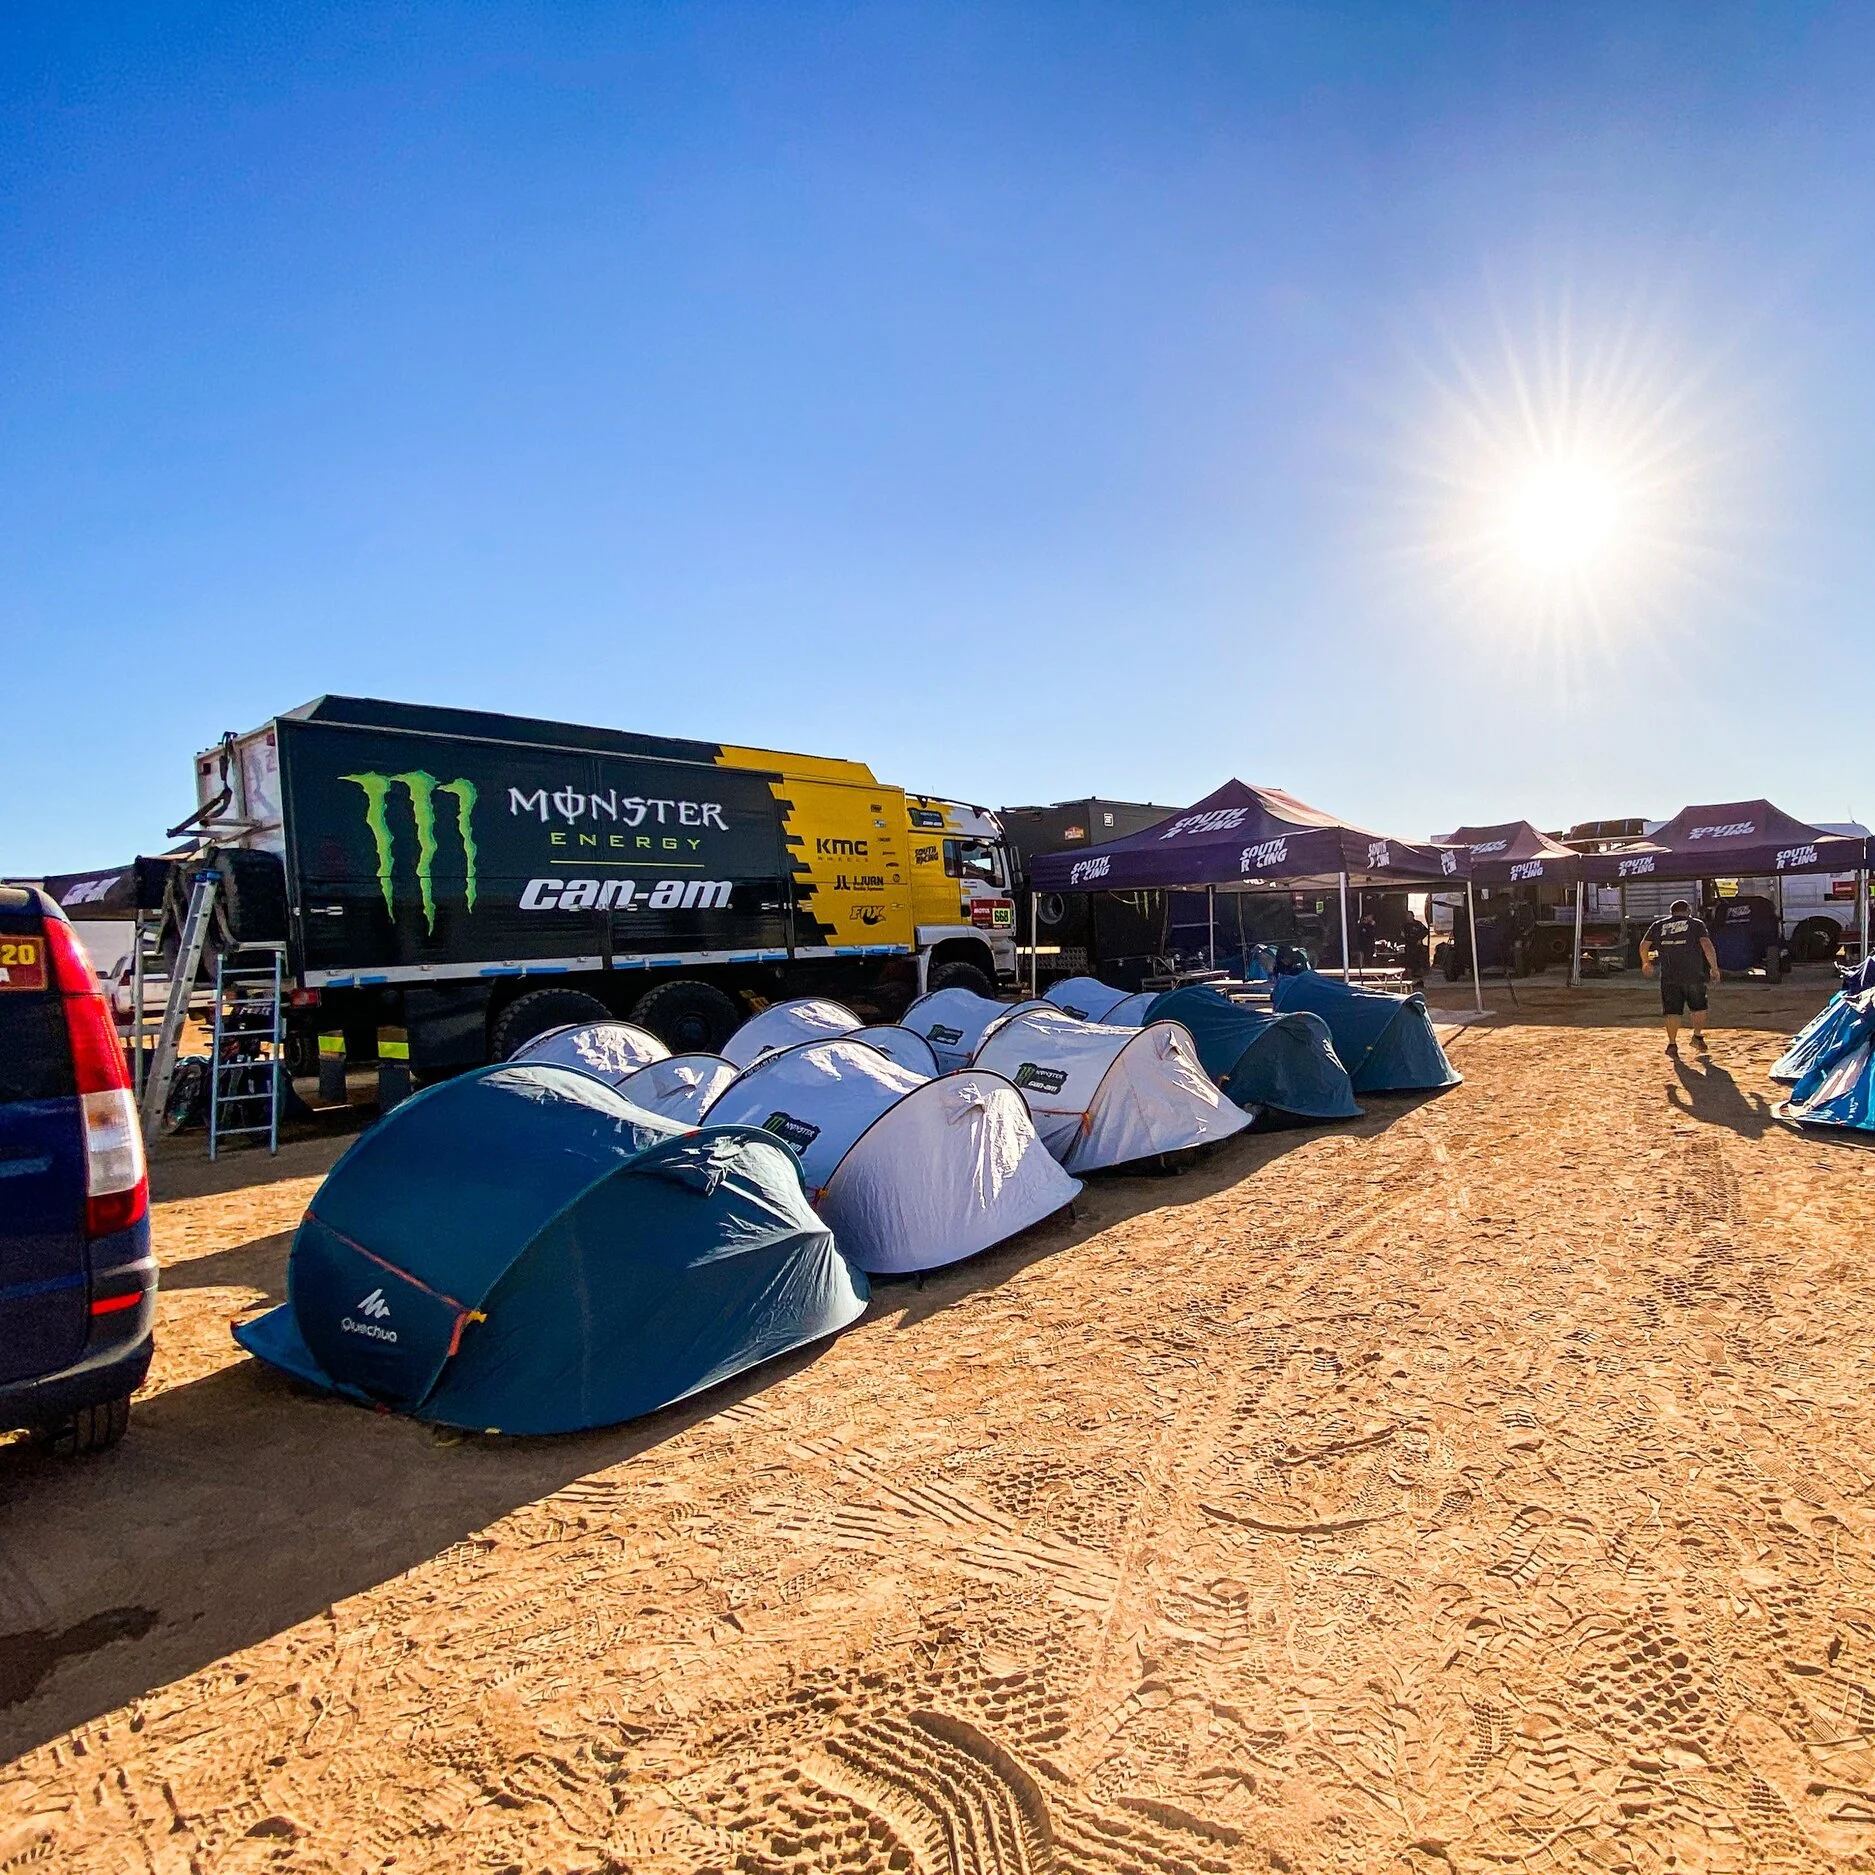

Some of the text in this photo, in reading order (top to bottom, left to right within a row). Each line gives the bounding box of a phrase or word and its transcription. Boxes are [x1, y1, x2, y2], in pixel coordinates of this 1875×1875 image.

[507, 785, 729, 831] MONSTER
[1159, 817, 1246, 840] RCING
[1168, 808, 1249, 832] SOUTH
[550, 832, 702, 850] ENERGY
[1688, 826, 1756, 840] RCING
[816, 838, 869, 856] KMC
[1239, 837, 1286, 860] SOUTH
[1775, 845, 1815, 861] SOUTH
[1071, 855, 1111, 874] SOUTH
[1240, 848, 1288, 873] RCING
[1509, 860, 1541, 875] SOUTH
[1618, 856, 1653, 870] SOUTH
[1776, 852, 1818, 870] RCING
[1070, 864, 1111, 885] RCING
[1510, 866, 1543, 882] RCING
[1619, 864, 1655, 877] RCING
[0, 944, 36, 965] 20
[341, 1317, 398, 1343] Quechua
